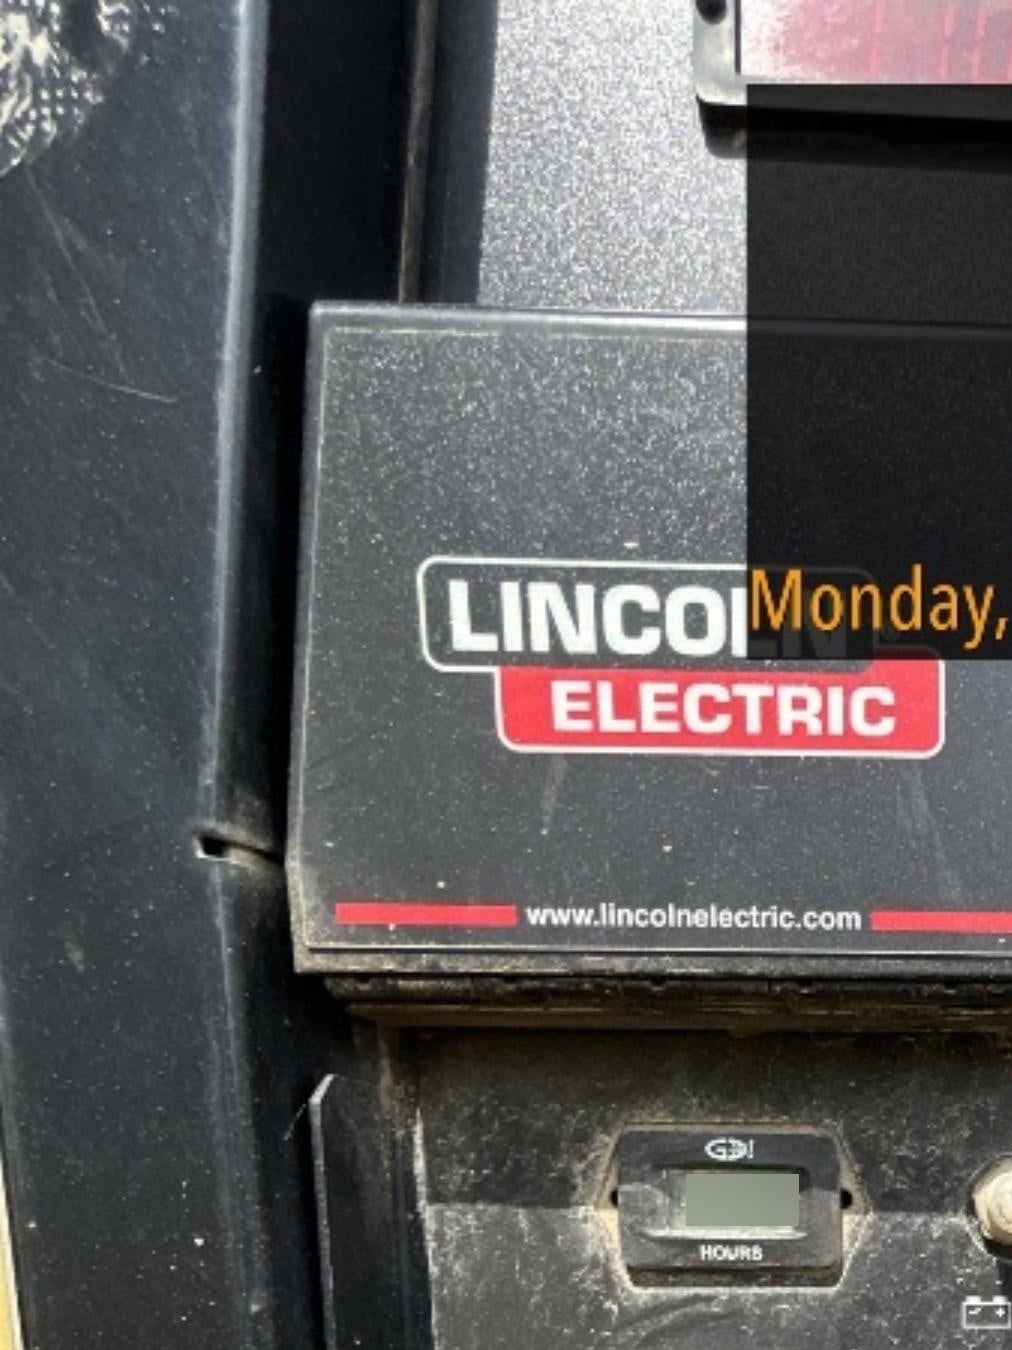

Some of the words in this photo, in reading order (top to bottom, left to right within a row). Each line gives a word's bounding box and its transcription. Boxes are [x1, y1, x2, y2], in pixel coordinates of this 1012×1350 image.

[550, 680, 898, 737] ELECTRIC
[526, 902, 862, 931] www.lincolnelectric.com
[700, 1244, 763, 1261] HOURS
